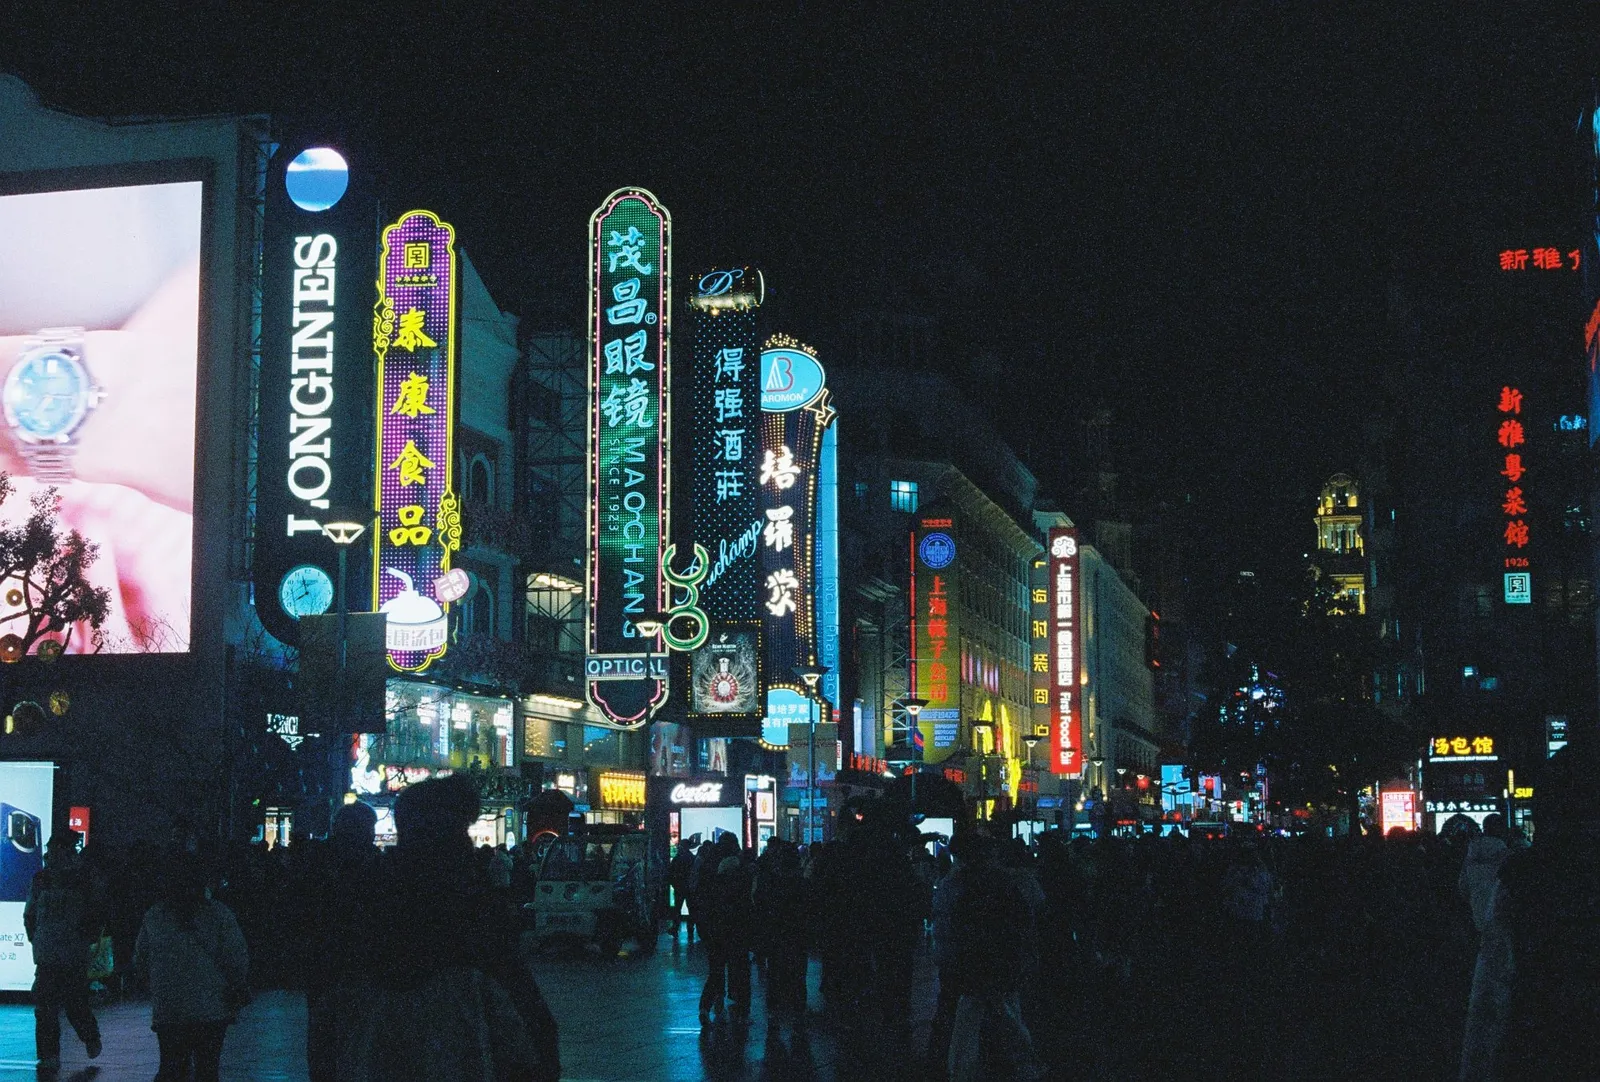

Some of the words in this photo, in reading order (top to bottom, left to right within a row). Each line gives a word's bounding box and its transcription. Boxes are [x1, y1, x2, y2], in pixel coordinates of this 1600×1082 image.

[601, 226, 655, 428] 茂昌眼镜
[287, 232, 338, 537] LONGINES
[761, 393, 804, 403] AROMON
[389, 306, 437, 547] 泰康食品
[609, 439, 620, 485] SINCE
[608, 495, 620, 531] 1923
[1504, 557, 1529, 568] 1926
[587, 659, 666, 673] OPTICAL
[1435, 737, 1494, 754] 汤包馆
[14, 933, 25, 941] X7
